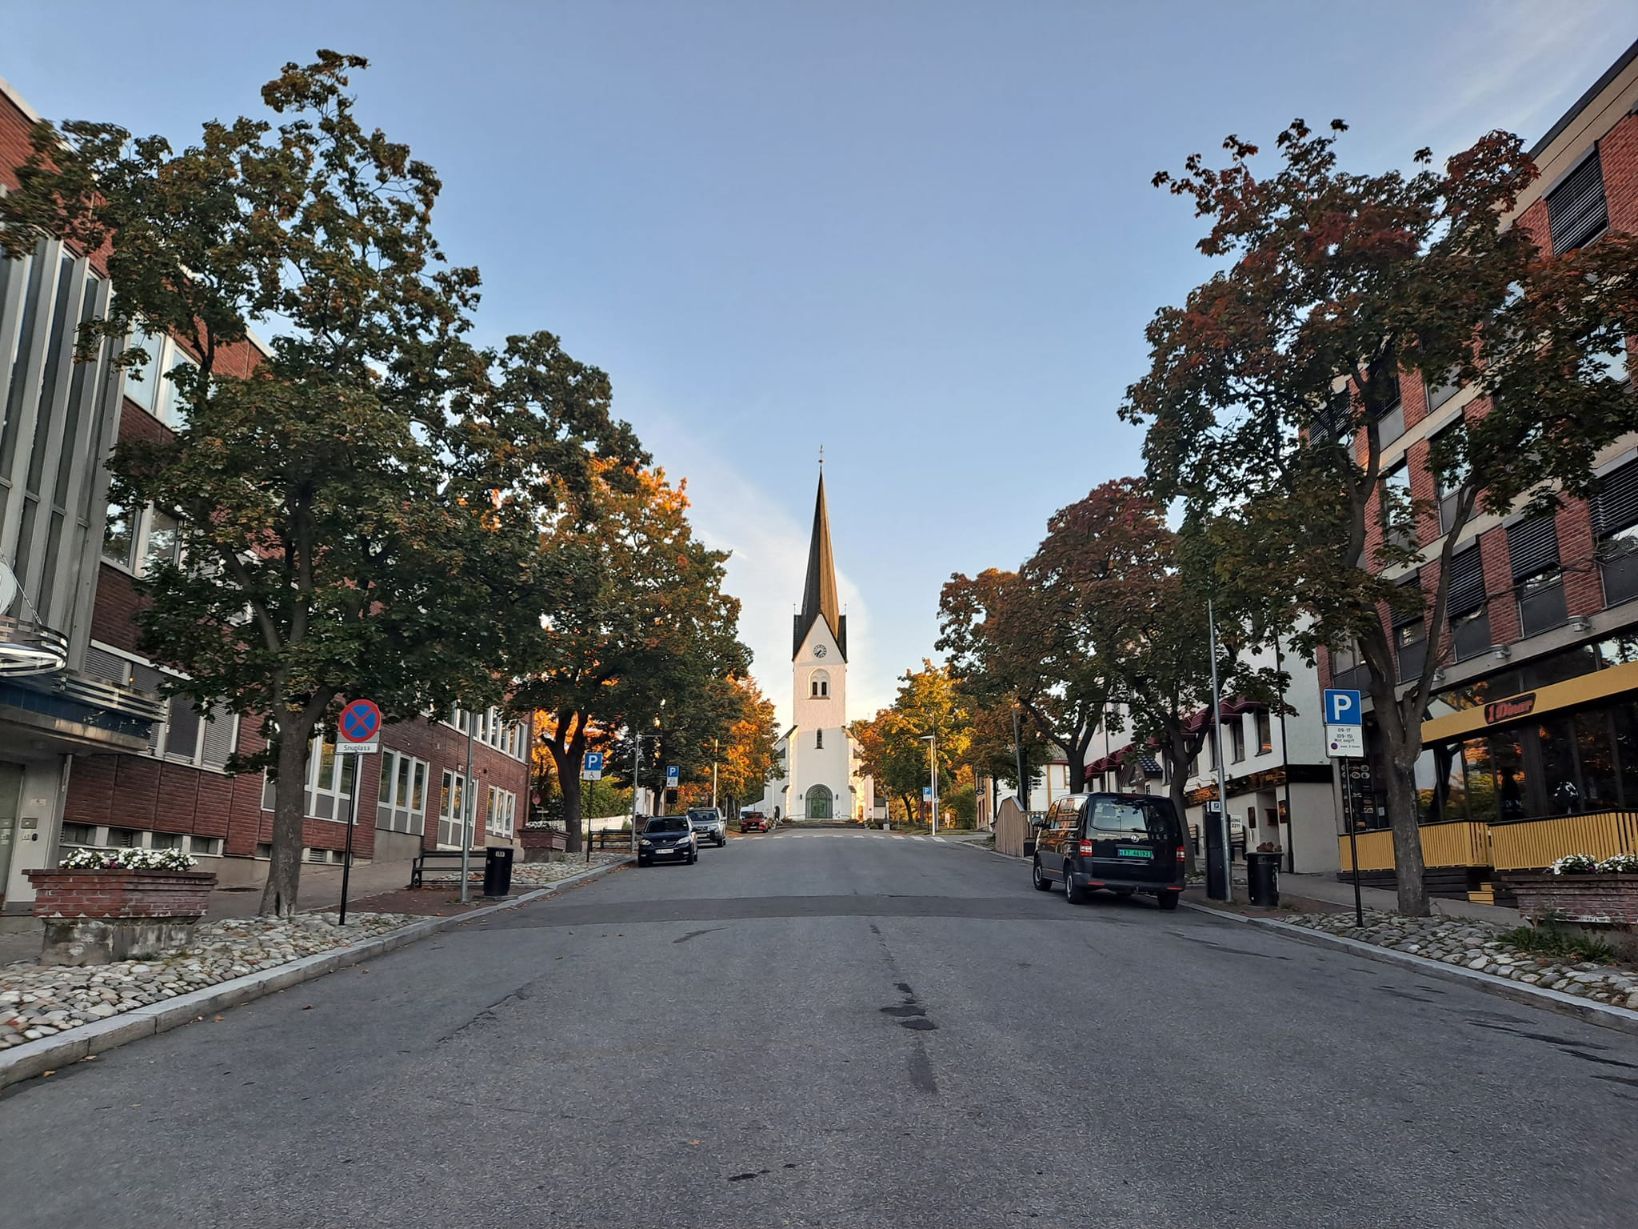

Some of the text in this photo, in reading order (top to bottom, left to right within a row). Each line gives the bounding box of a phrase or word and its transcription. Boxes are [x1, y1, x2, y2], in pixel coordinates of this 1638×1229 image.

[1333, 694, 1352, 720] P
[588, 755, 598, 769] P
[669, 767, 676, 776] P
